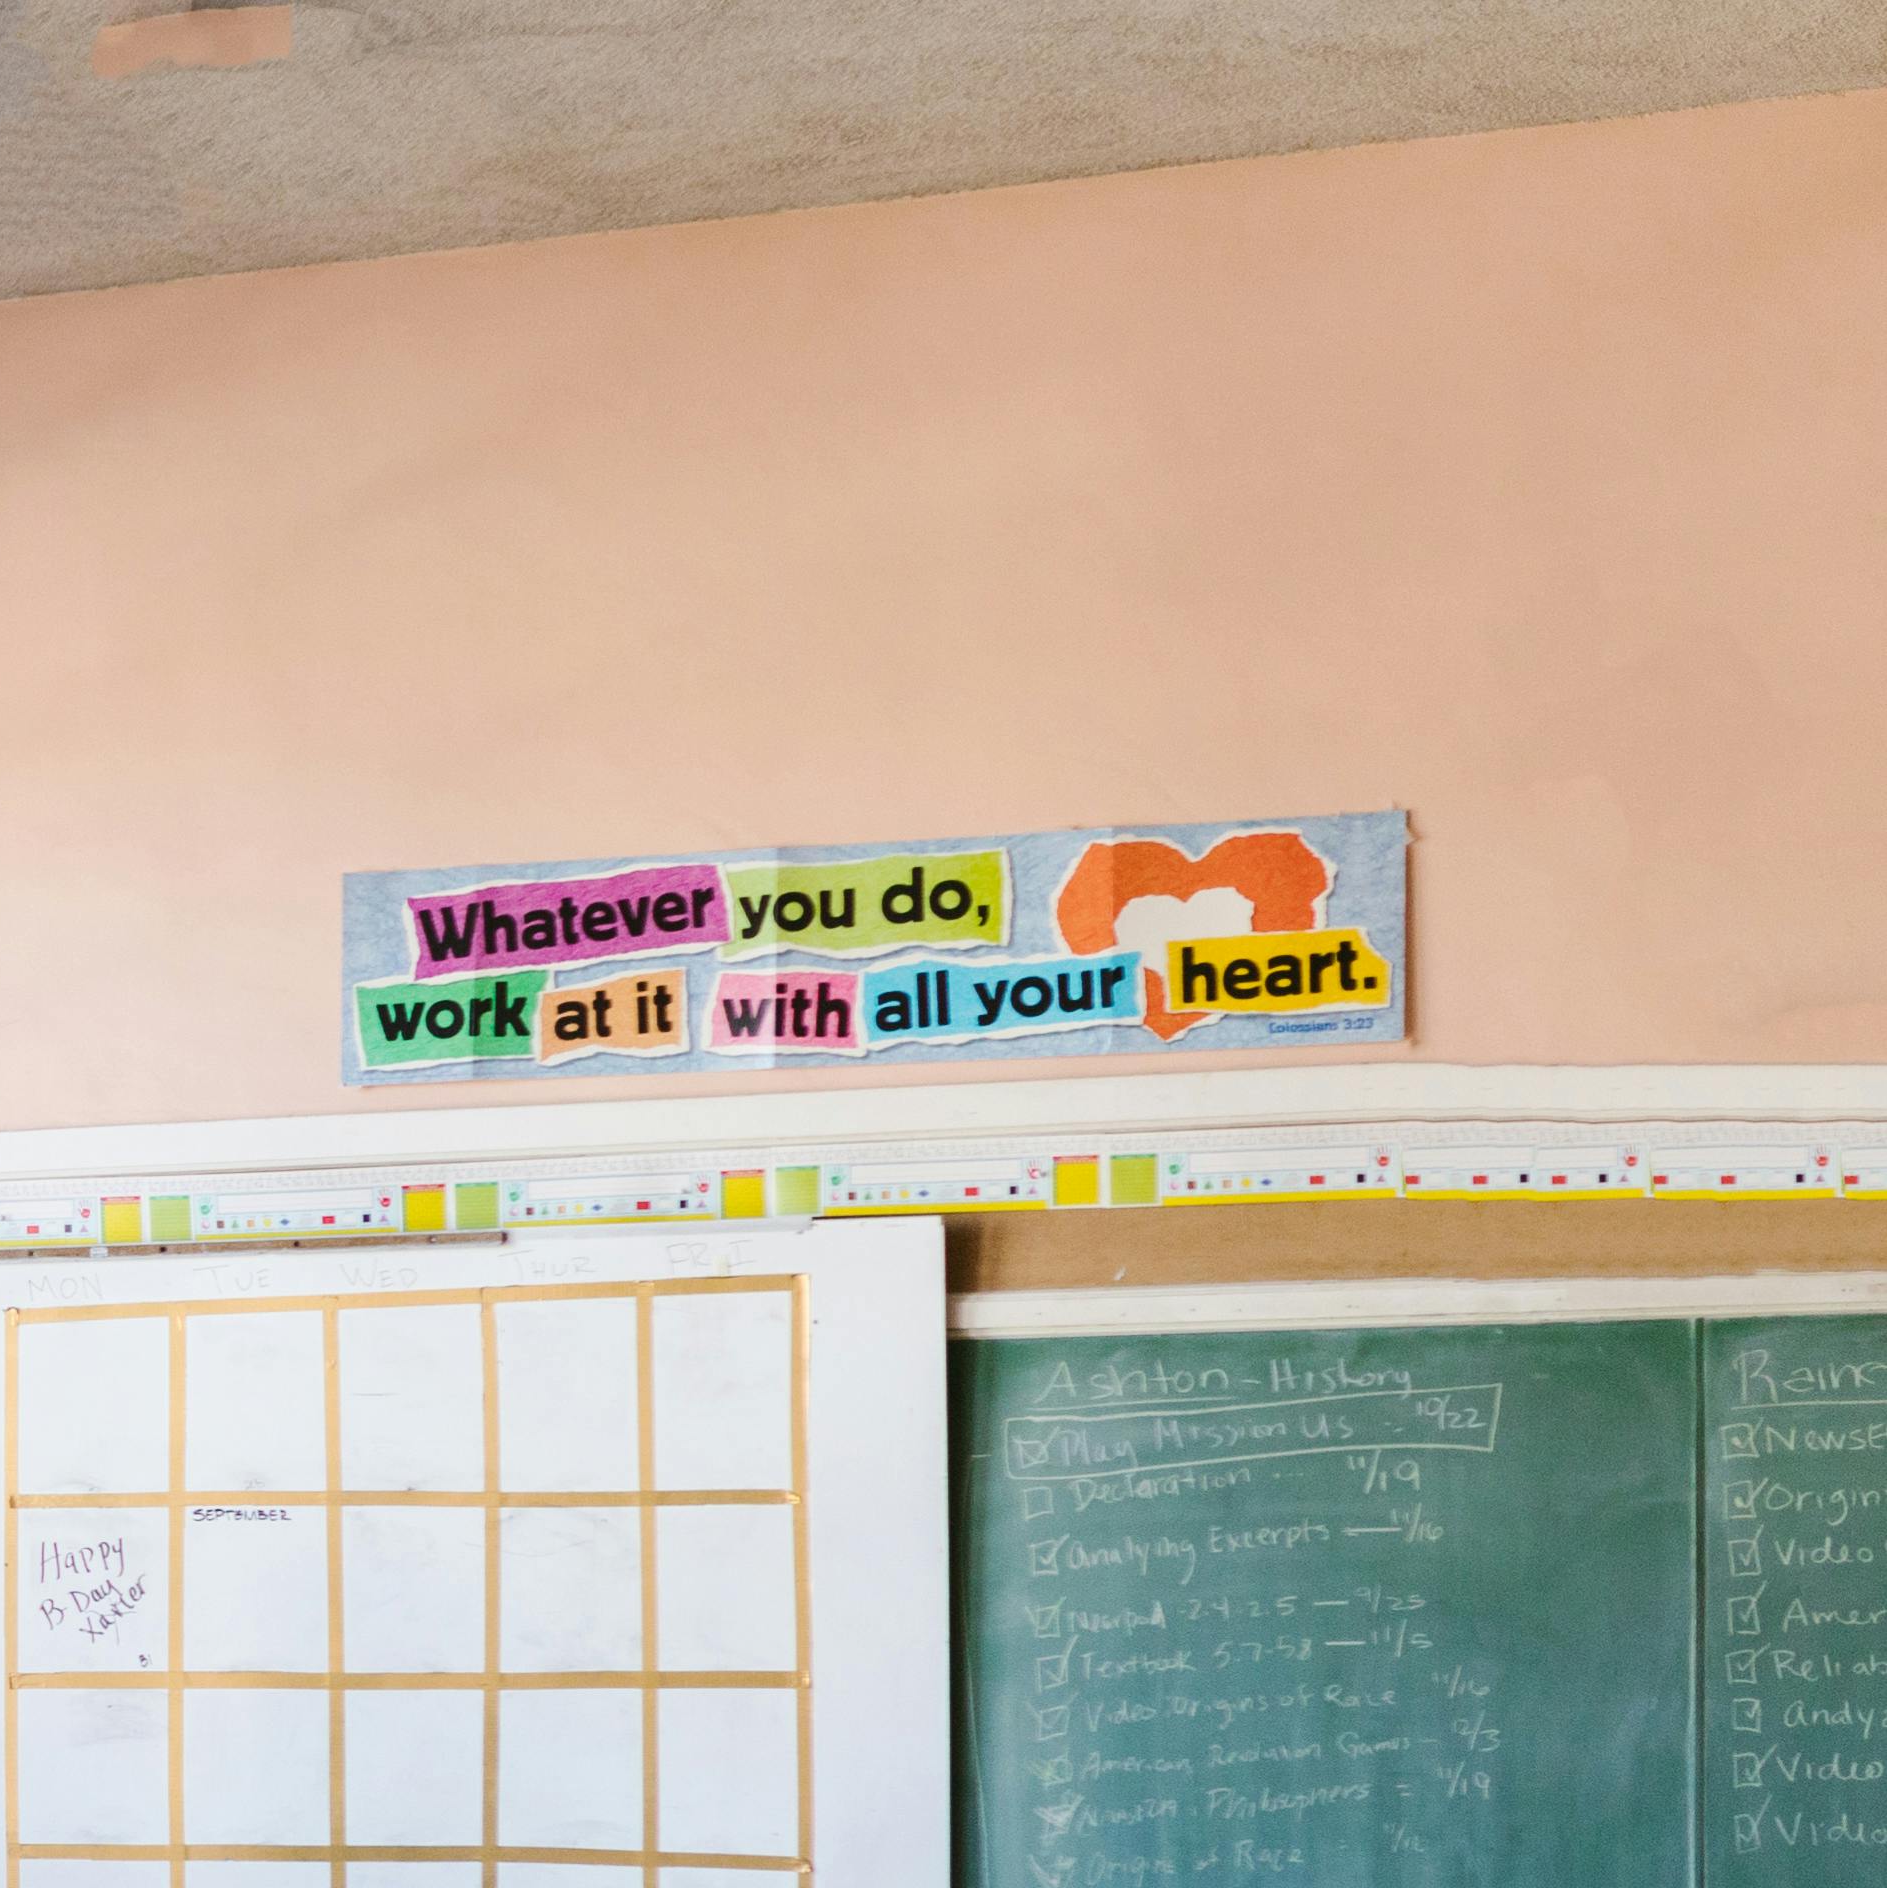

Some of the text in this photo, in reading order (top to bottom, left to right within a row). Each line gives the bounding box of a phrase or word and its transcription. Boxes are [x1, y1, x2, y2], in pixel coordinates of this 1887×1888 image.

[418, 867, 989, 962] Whatever you do,
[376, 941, 1378, 1041] work at it with all your heart.
[1269, 1017, 1374, 1034] Colossians 3:23
[26, 1274, 104, 1302] MON
[193, 1264, 271, 1292] TUE
[339, 1257, 419, 1289] WED
[1036, 1357, 1413, 1403] Ashton History
[1069, 1467, 1251, 1511] Declaration
[1764, 1483, 1887, 1526] Origin
[192, 1507, 292, 1522] SEPTEMBER
[1207, 1516, 1330, 1552] Excerpts
[1774, 1536, 1875, 1566] Video
[1776, 1752, 1885, 1783] Video
[1774, 1812, 1887, 1847] Video
